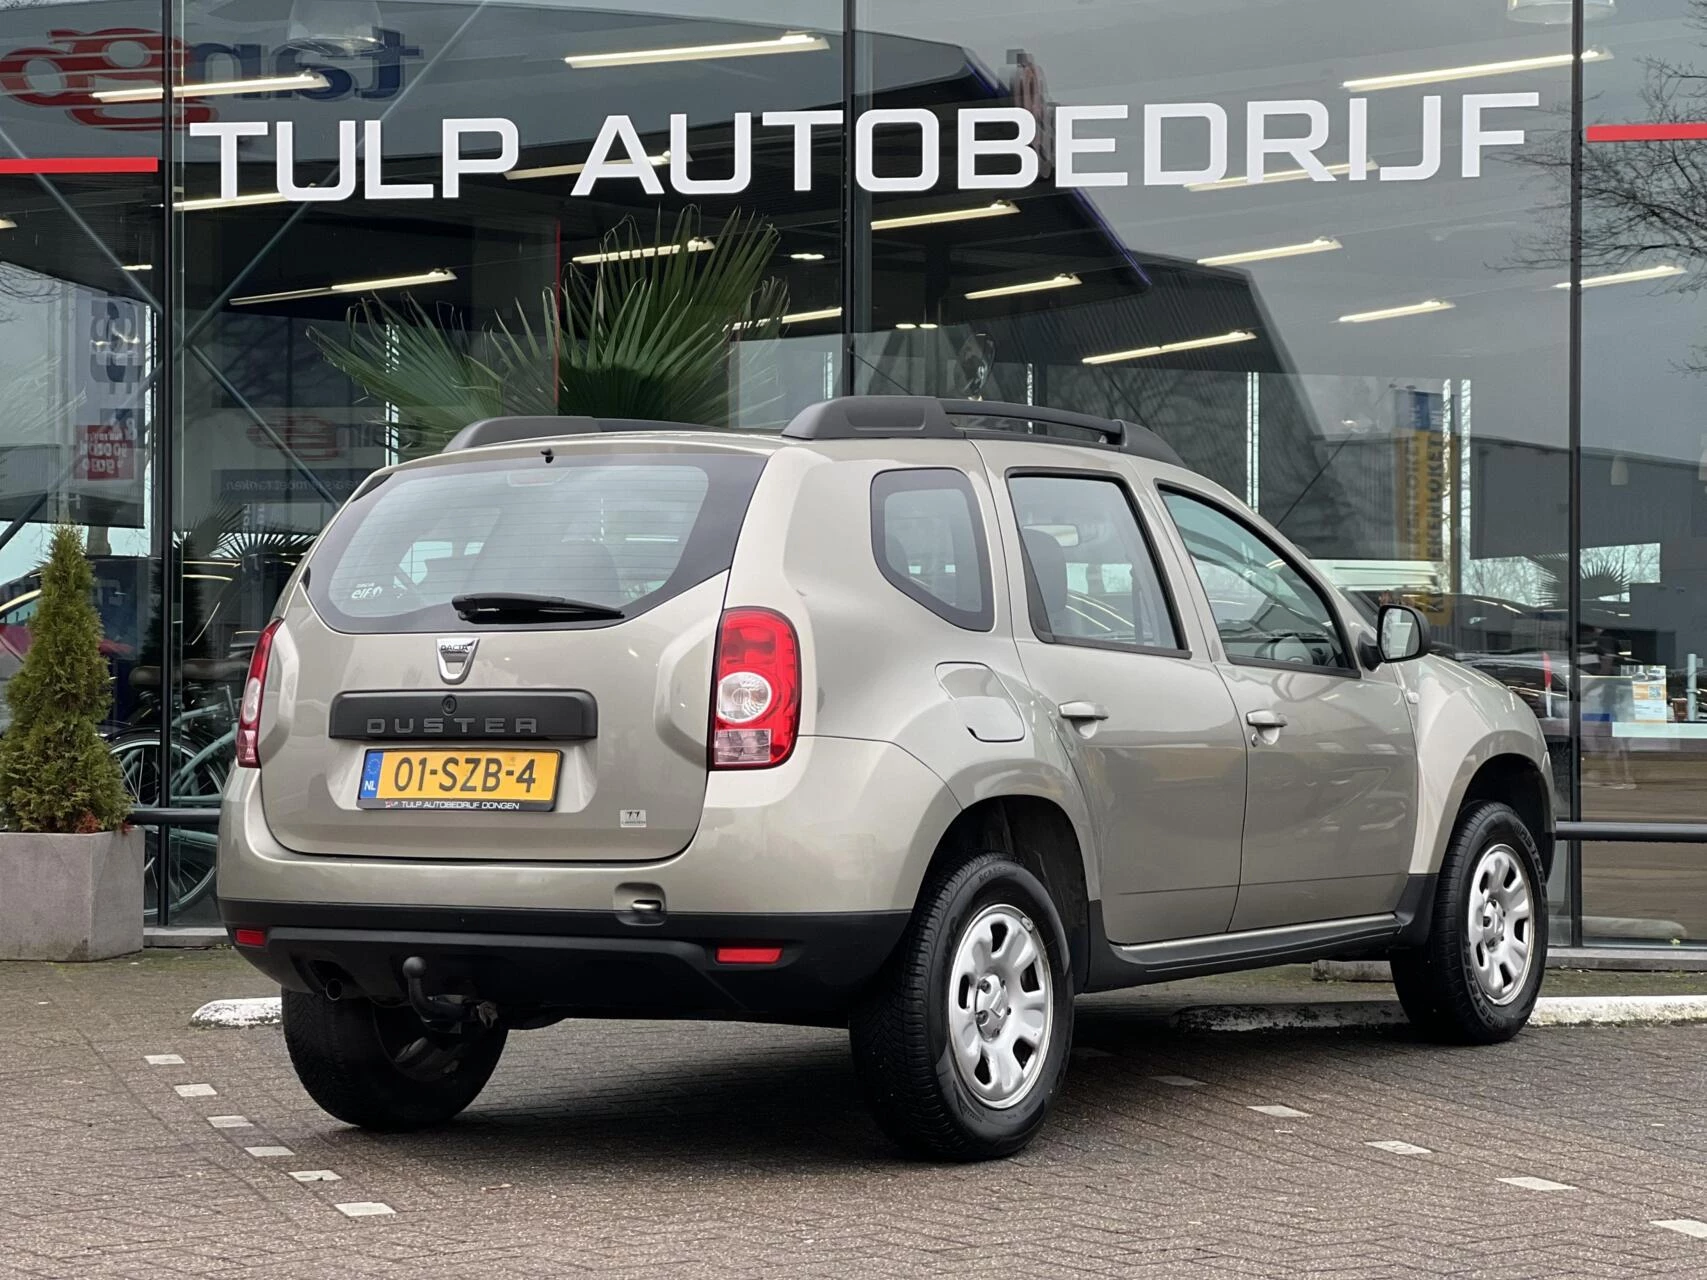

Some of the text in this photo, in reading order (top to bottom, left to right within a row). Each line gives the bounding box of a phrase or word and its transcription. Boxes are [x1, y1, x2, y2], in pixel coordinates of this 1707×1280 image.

[189, 91, 1540, 202] TULP AUTOBEDRIJF
[440, 643, 469, 651] DACIA
[366, 717, 537, 734] DUSTER
[394, 756, 537, 793] 01-SZB-4
[364, 780, 377, 792] NL
[401, 800, 422, 809] TULP
[481, 801, 519, 810] DONGEN
